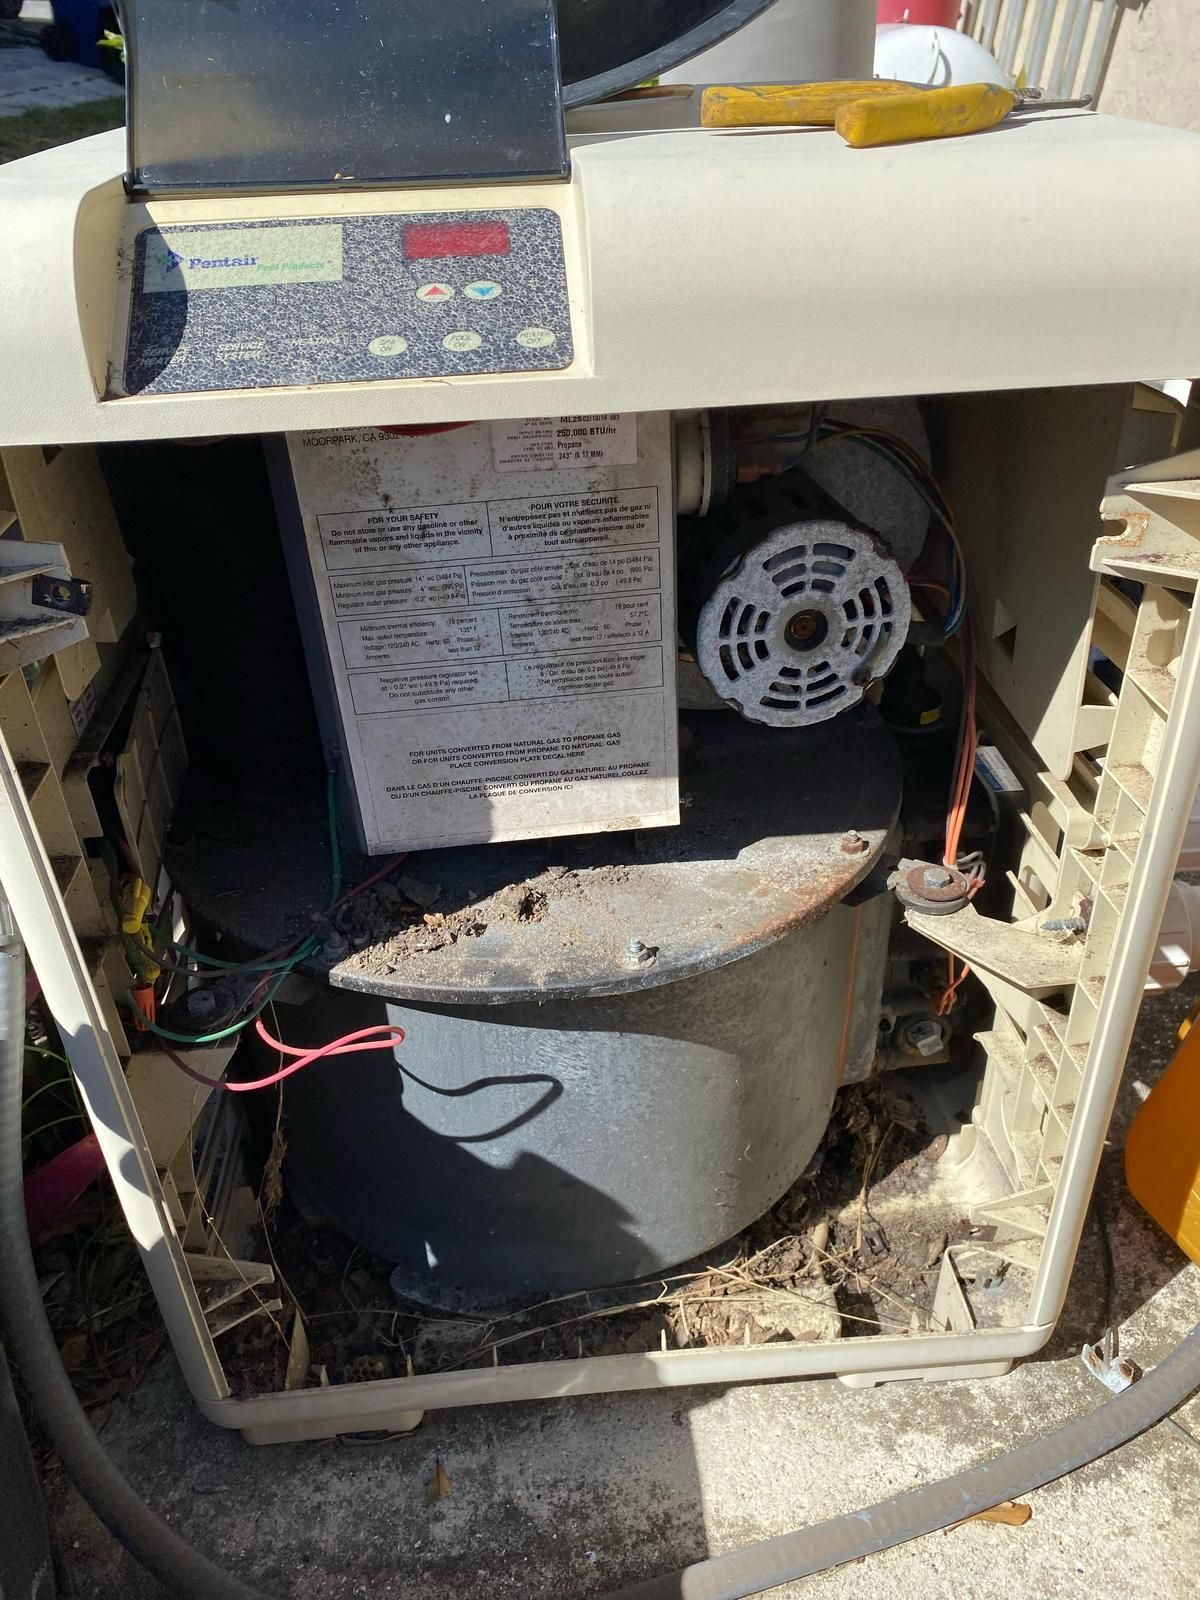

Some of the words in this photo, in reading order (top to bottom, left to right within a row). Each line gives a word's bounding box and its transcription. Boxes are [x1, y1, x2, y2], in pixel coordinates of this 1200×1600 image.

[188, 255, 258, 270] Pentair
[256, 264, 280, 272] Pool
[282, 261, 326, 270] Products
[218, 342, 264, 351] SERVICE
[290, 338, 338, 346] HEATING
[216, 352, 262, 360] SYSTEM
[589, 425, 616, 436] BTU/hr
[302, 434, 360, 447] MOORPARK,
[362, 433, 376, 442] CA
[557, 440, 582, 451] Propane
[530, 500, 552, 510] POUR
[554, 498, 579, 508] VOTRE
[581, 495, 619, 506] SÉCURITÉ
[386, 514, 408, 522] YOUR
[409, 512, 439, 520] SAFETY
[502, 522, 531, 531] d'autres
[532, 520, 560, 530] liquides
[573, 518, 601, 527] vapeurs
[602, 512, 649, 522] inflammables
[417, 520, 448, 531] gasoline
[329, 536, 367, 546] flammable
[369, 536, 394, 544] vapors
[410, 531, 435, 541] liquids
[457, 526, 482, 537] vicinity
[514, 530, 547, 541] proximité
[423, 538, 460, 549] appliance.
[379, 675, 408, 684] Negative
[438, 670, 467, 679] regulator
[552, 675, 583, 685] remplacez
[411, 688, 443, 696] substitute
[557, 682, 592, 691] commande
[447, 744, 490, 753] CONVERTED
[573, 733, 605, 741] PROPANE
[461, 751, 504, 760] CONVERTED
[571, 742, 603, 750] NATURAL
[473, 757, 518, 766] CONVERSION
[451, 775, 512, 786] CHAUFFE-PISCINE
[513, 772, 547, 780] CONVERTI
[420, 786, 482, 796] CHAUFFE-PISCINE
[518, 785, 562, 794] CONVERSION
